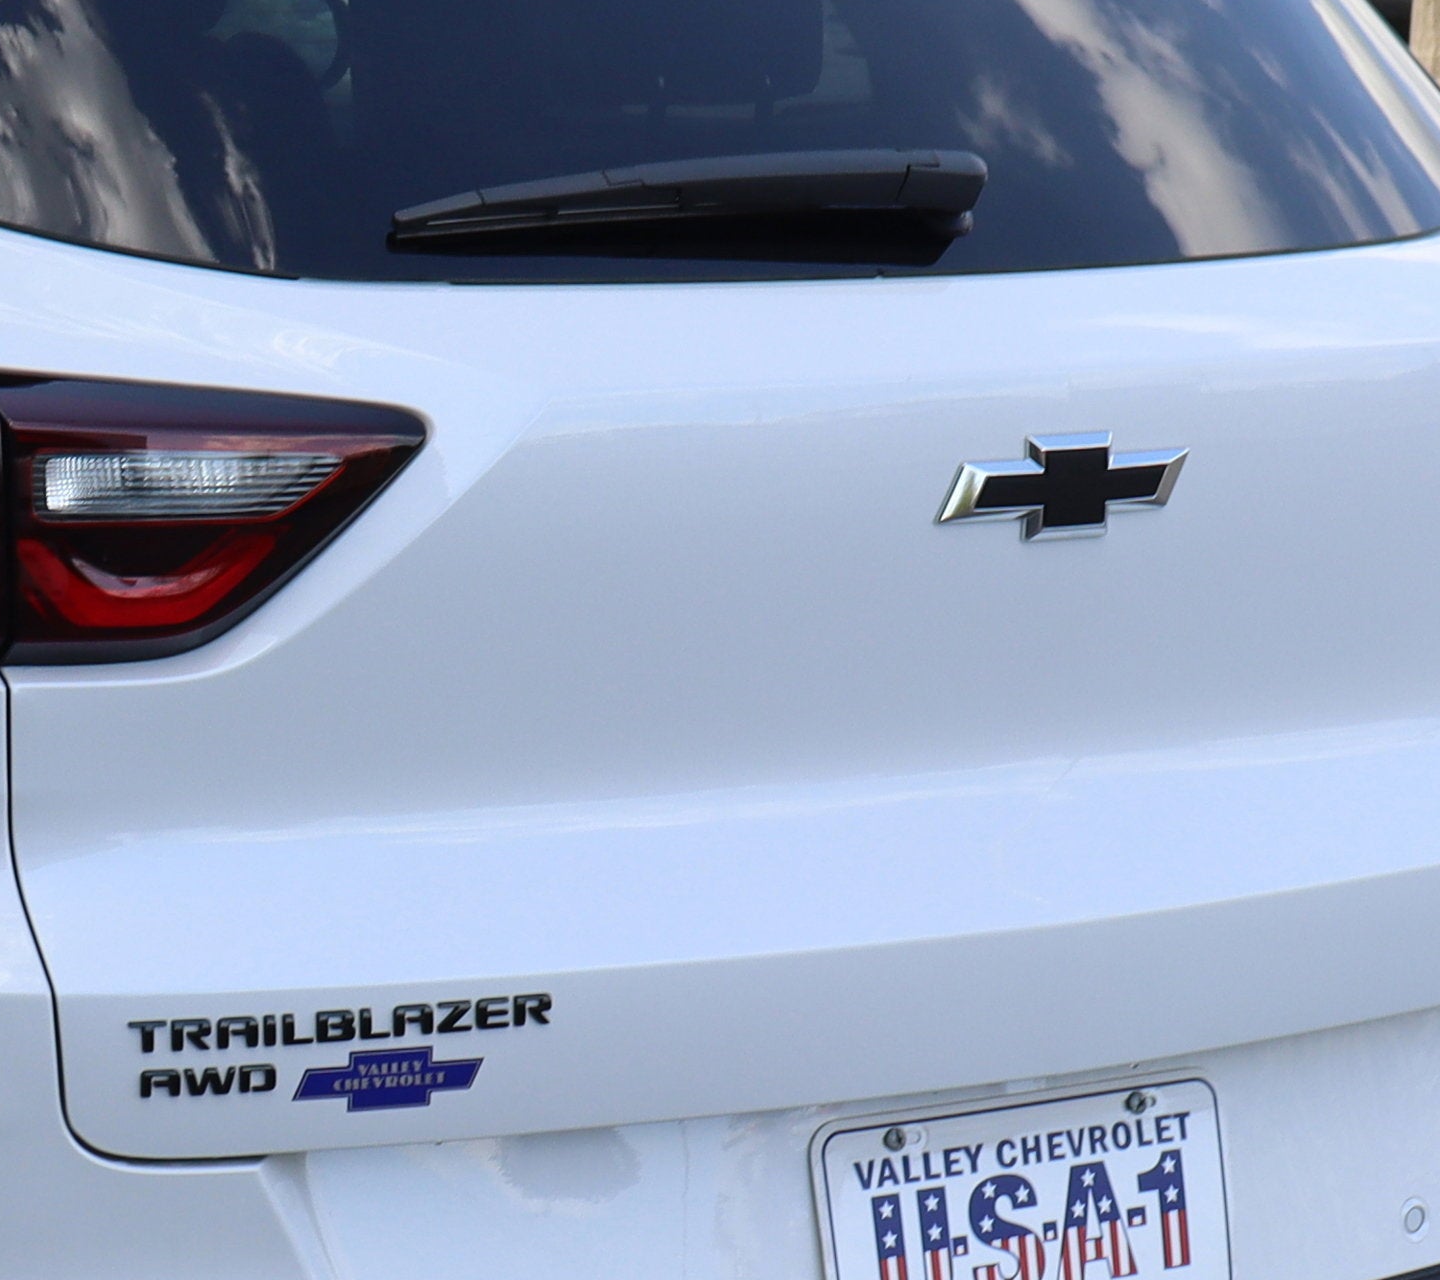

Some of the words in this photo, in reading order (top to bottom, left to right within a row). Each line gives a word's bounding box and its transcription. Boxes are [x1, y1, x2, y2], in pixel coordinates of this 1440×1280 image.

[128, 993, 552, 1053] TRAILBLAZER
[140, 1064, 276, 1098] AWD
[332, 1072, 446, 1092] CHEVROLET
[357, 1058, 424, 1076] VALLEY
[854, 1143, 983, 1191] VALLEY
[996, 1111, 1192, 1168] CHEVROLET
